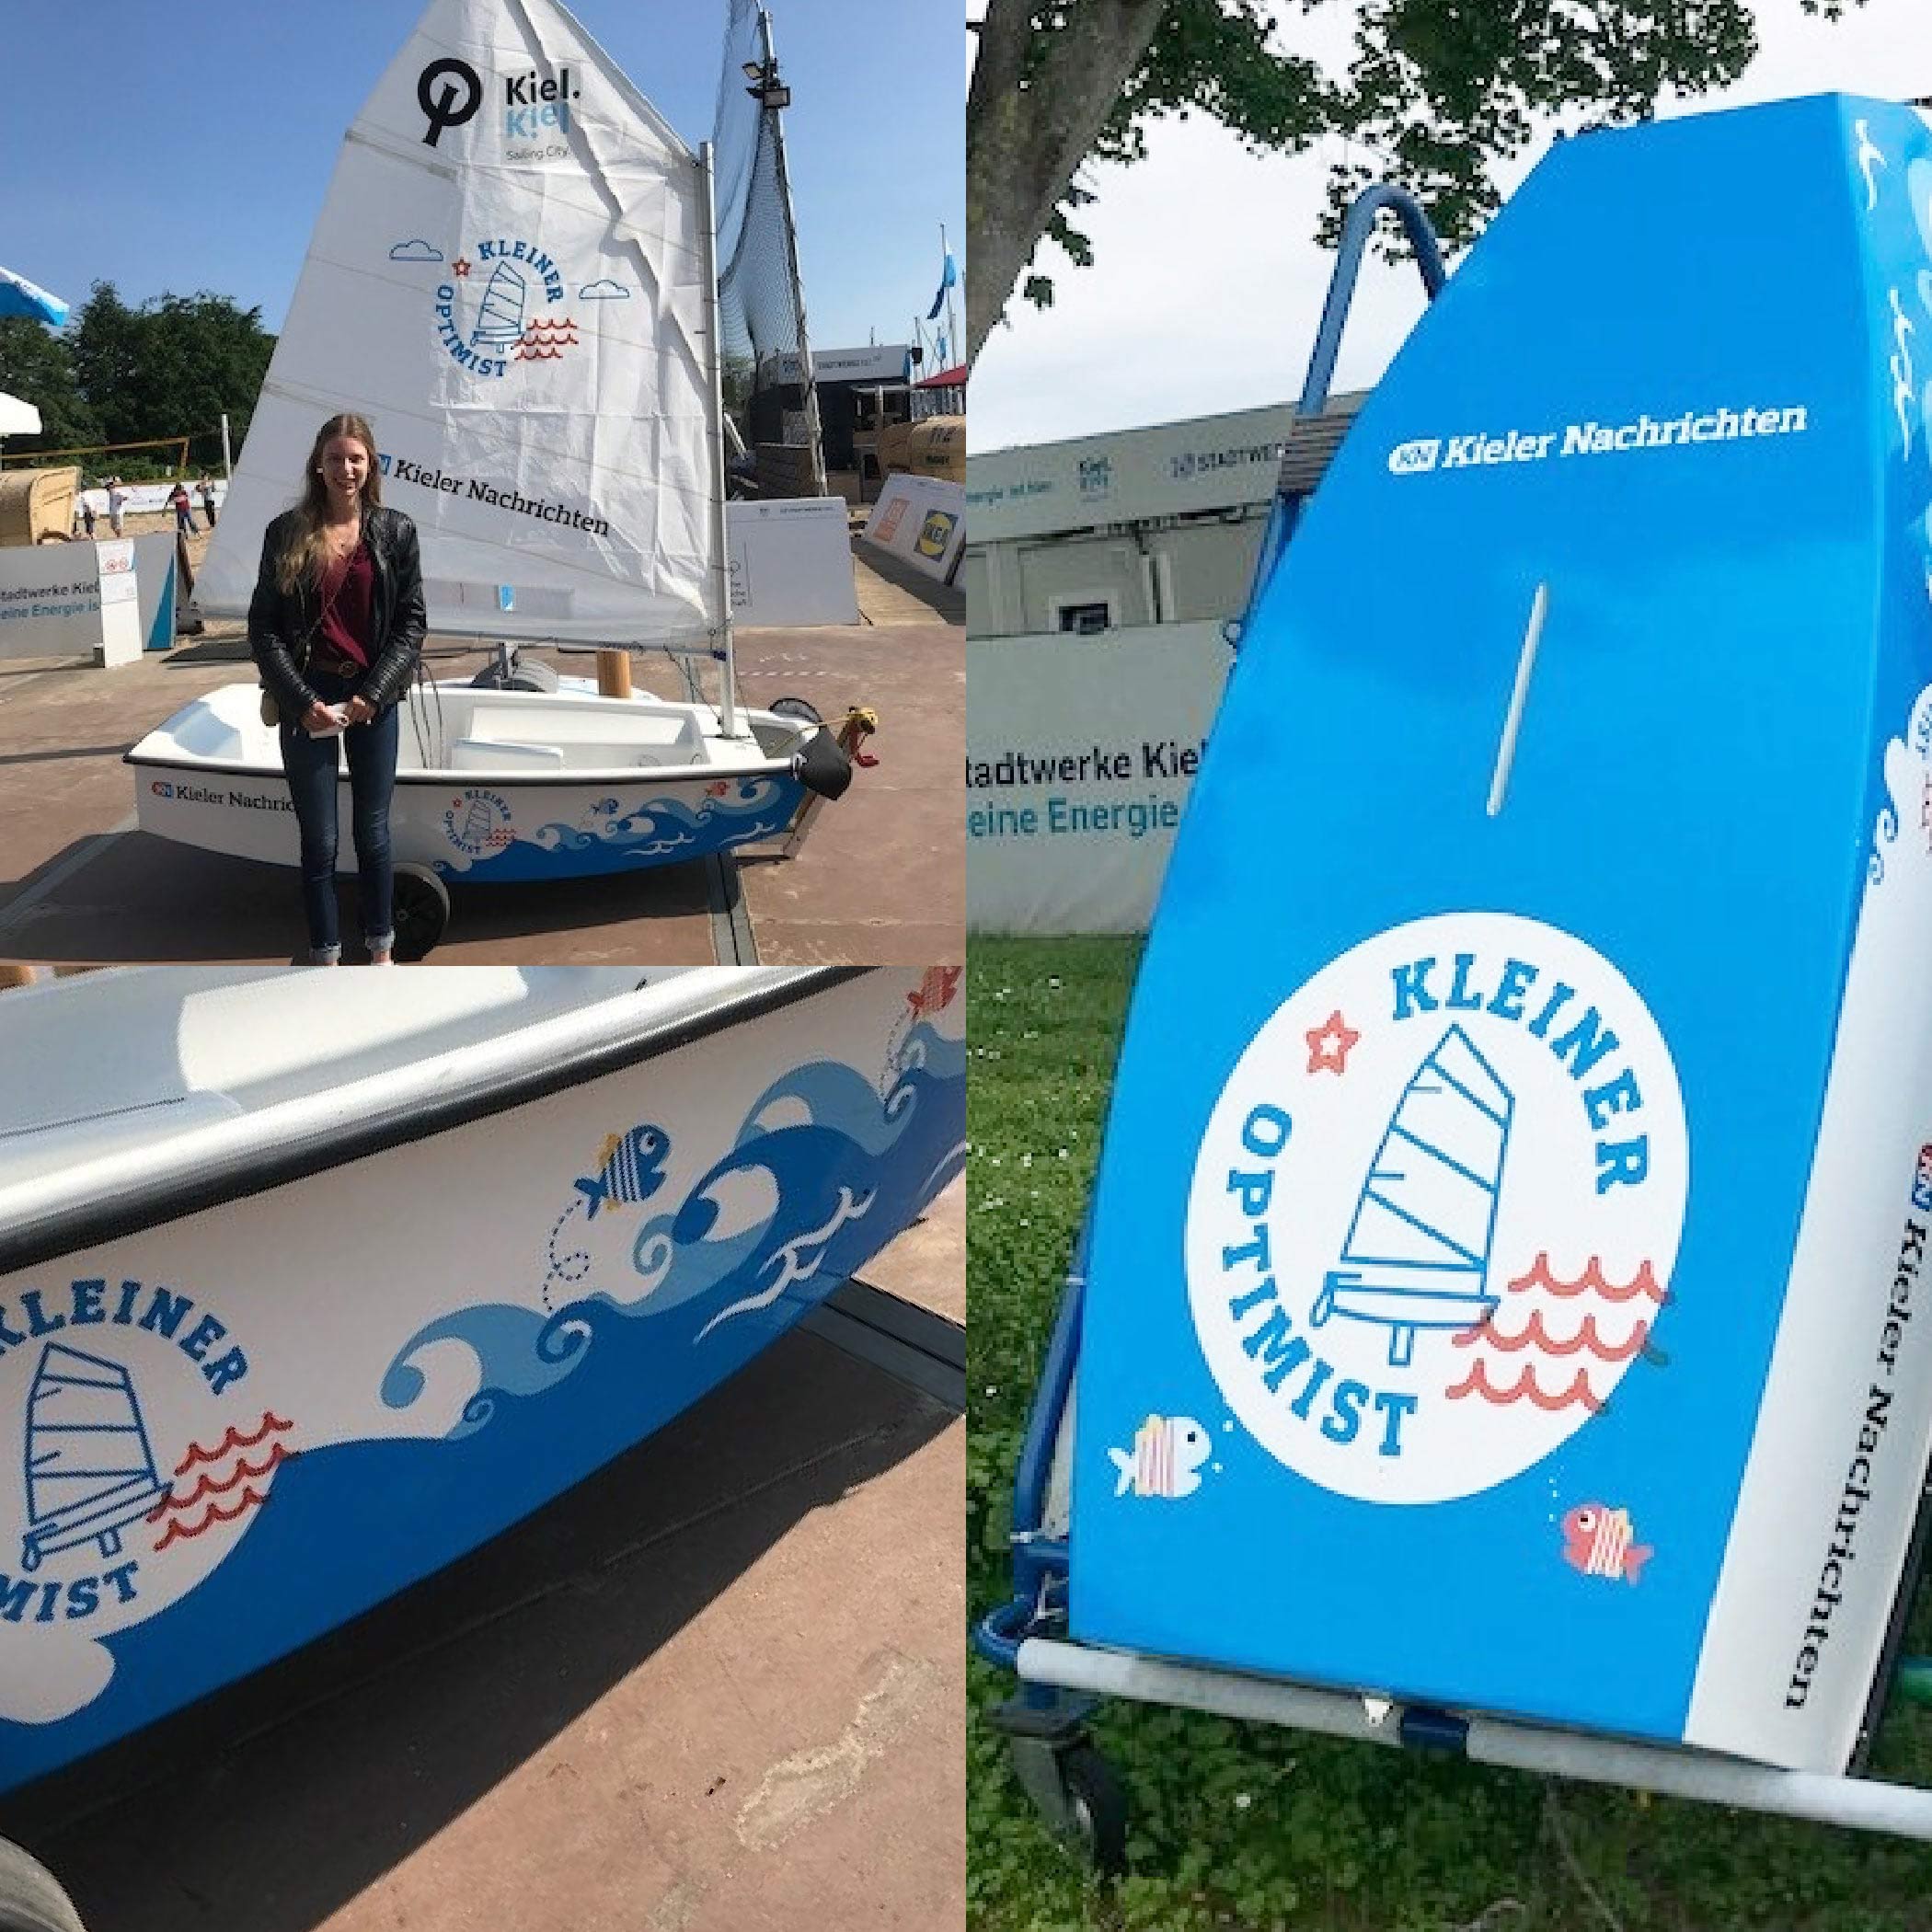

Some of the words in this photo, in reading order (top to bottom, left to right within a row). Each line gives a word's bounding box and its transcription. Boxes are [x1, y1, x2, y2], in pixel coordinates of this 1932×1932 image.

[506, 68, 581, 107] Kiel.
[477, 239, 564, 304] KLEINER
[436, 284, 507, 377] OPTIMIST
[1442, 430, 1558, 468] Kieler
[1560, 405, 1807, 458] Nachrichten
[394, 459, 464, 497] Kieler
[466, 478, 609, 537] Nachrichten
[177, 786, 224, 805] Kieler
[969, 799, 1039, 838] eine
[1048, 795, 1179, 838] Energie
[1392, 953, 1650, 1195] KLEINER
[1223, 1104, 1418, 1457] OPTIMIST
[1875, 1218, 1926, 1377] Kieler
[1784, 1383, 1892, 1710] Nachrichten
